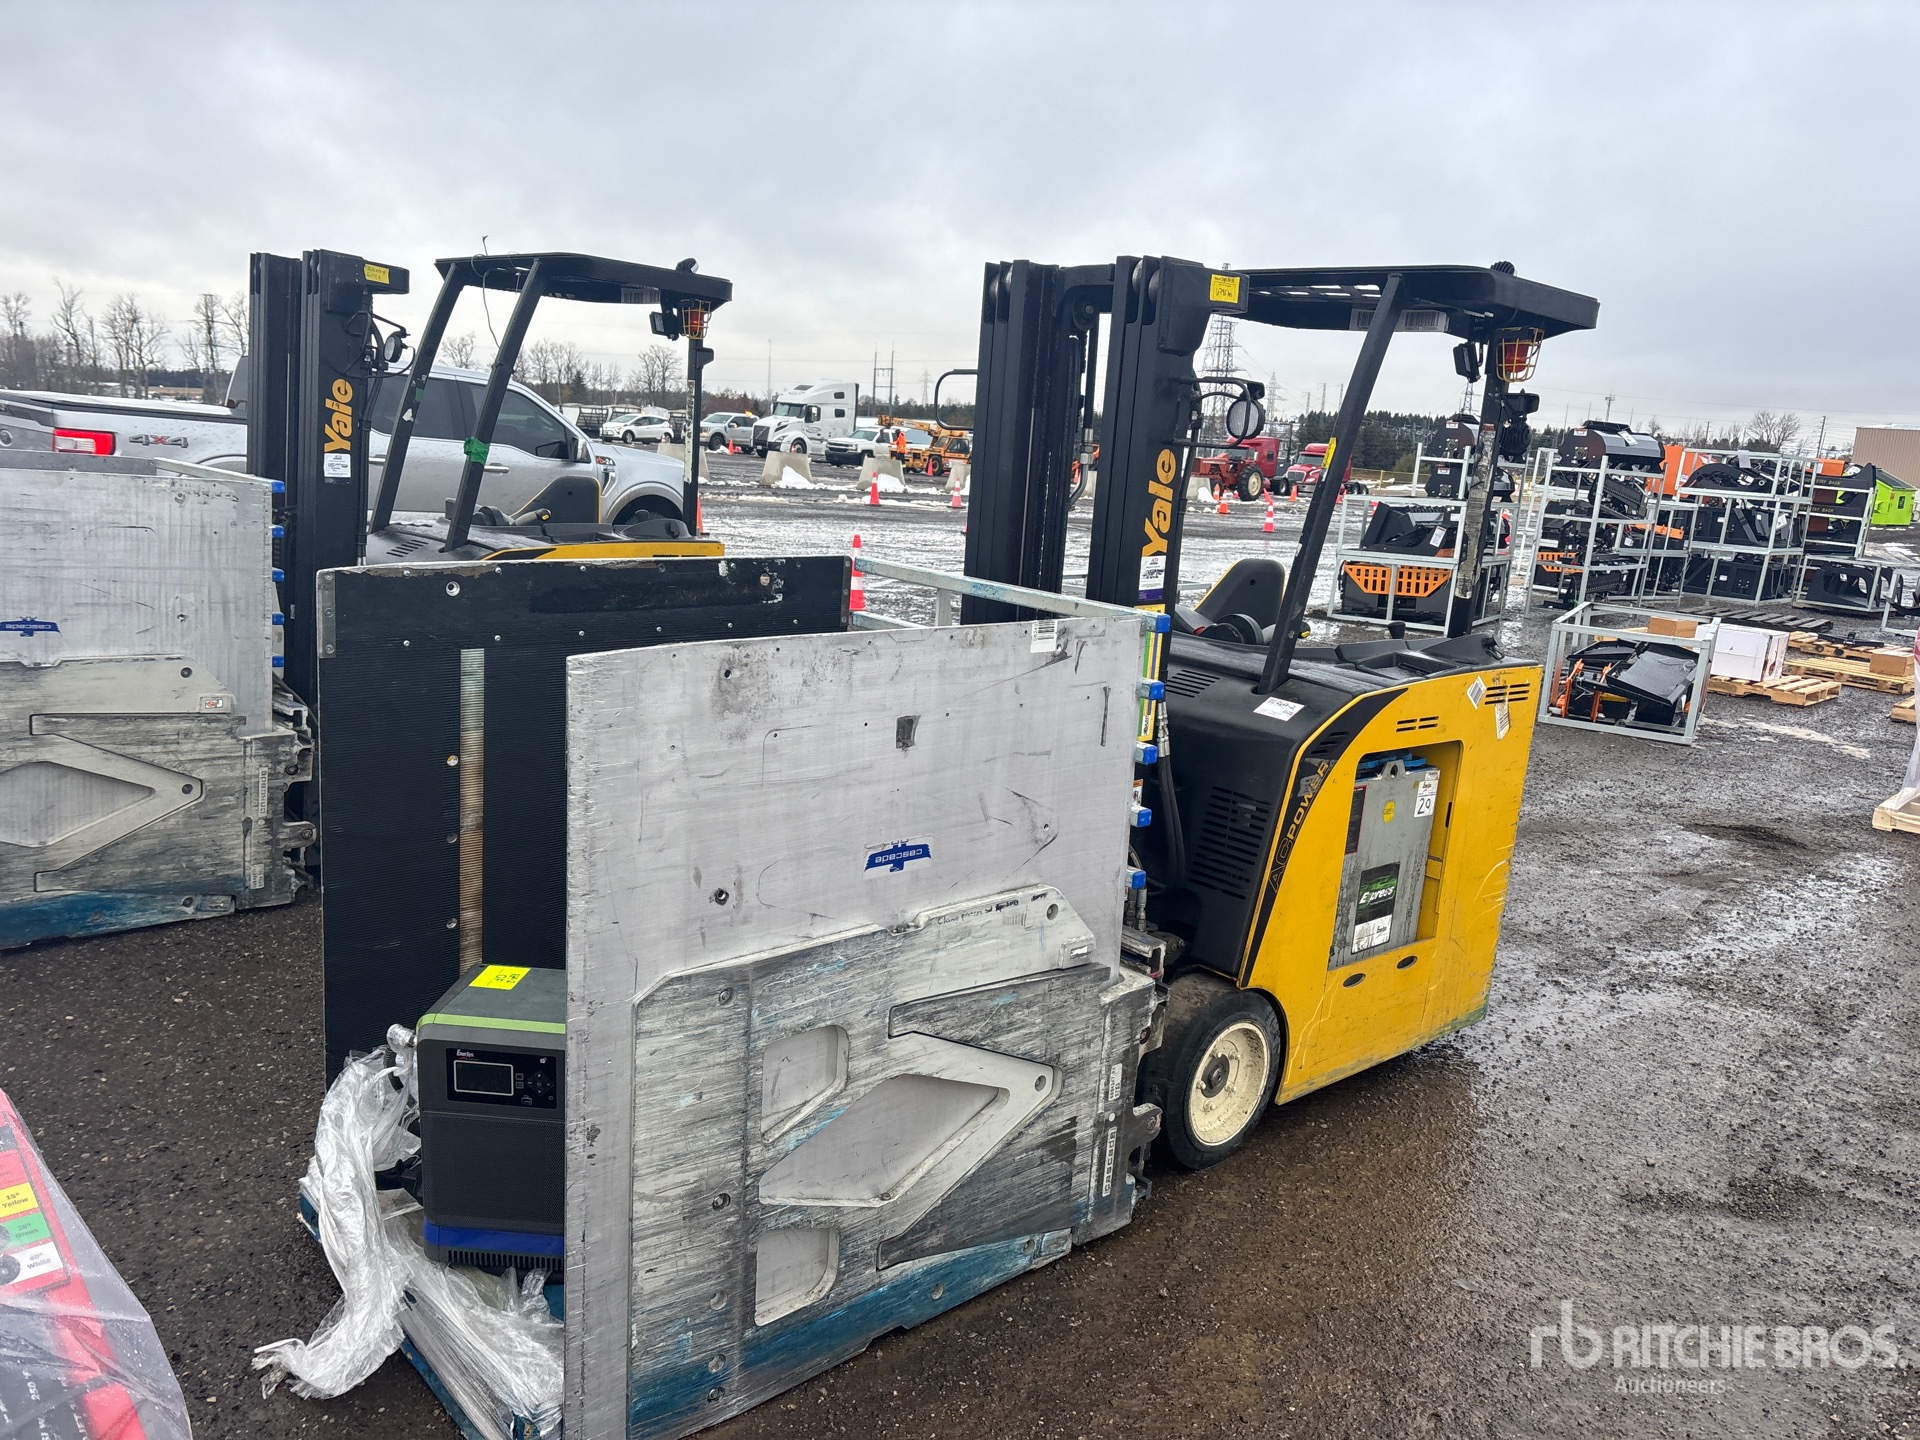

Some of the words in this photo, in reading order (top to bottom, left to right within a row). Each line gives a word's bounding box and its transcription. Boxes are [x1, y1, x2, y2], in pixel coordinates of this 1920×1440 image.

[323, 378, 353, 453] Yale
[1141, 448, 1177, 557] Yale
[875, 848, 923, 864] cascade
[2, 1197, 29, 1209] Yellow
